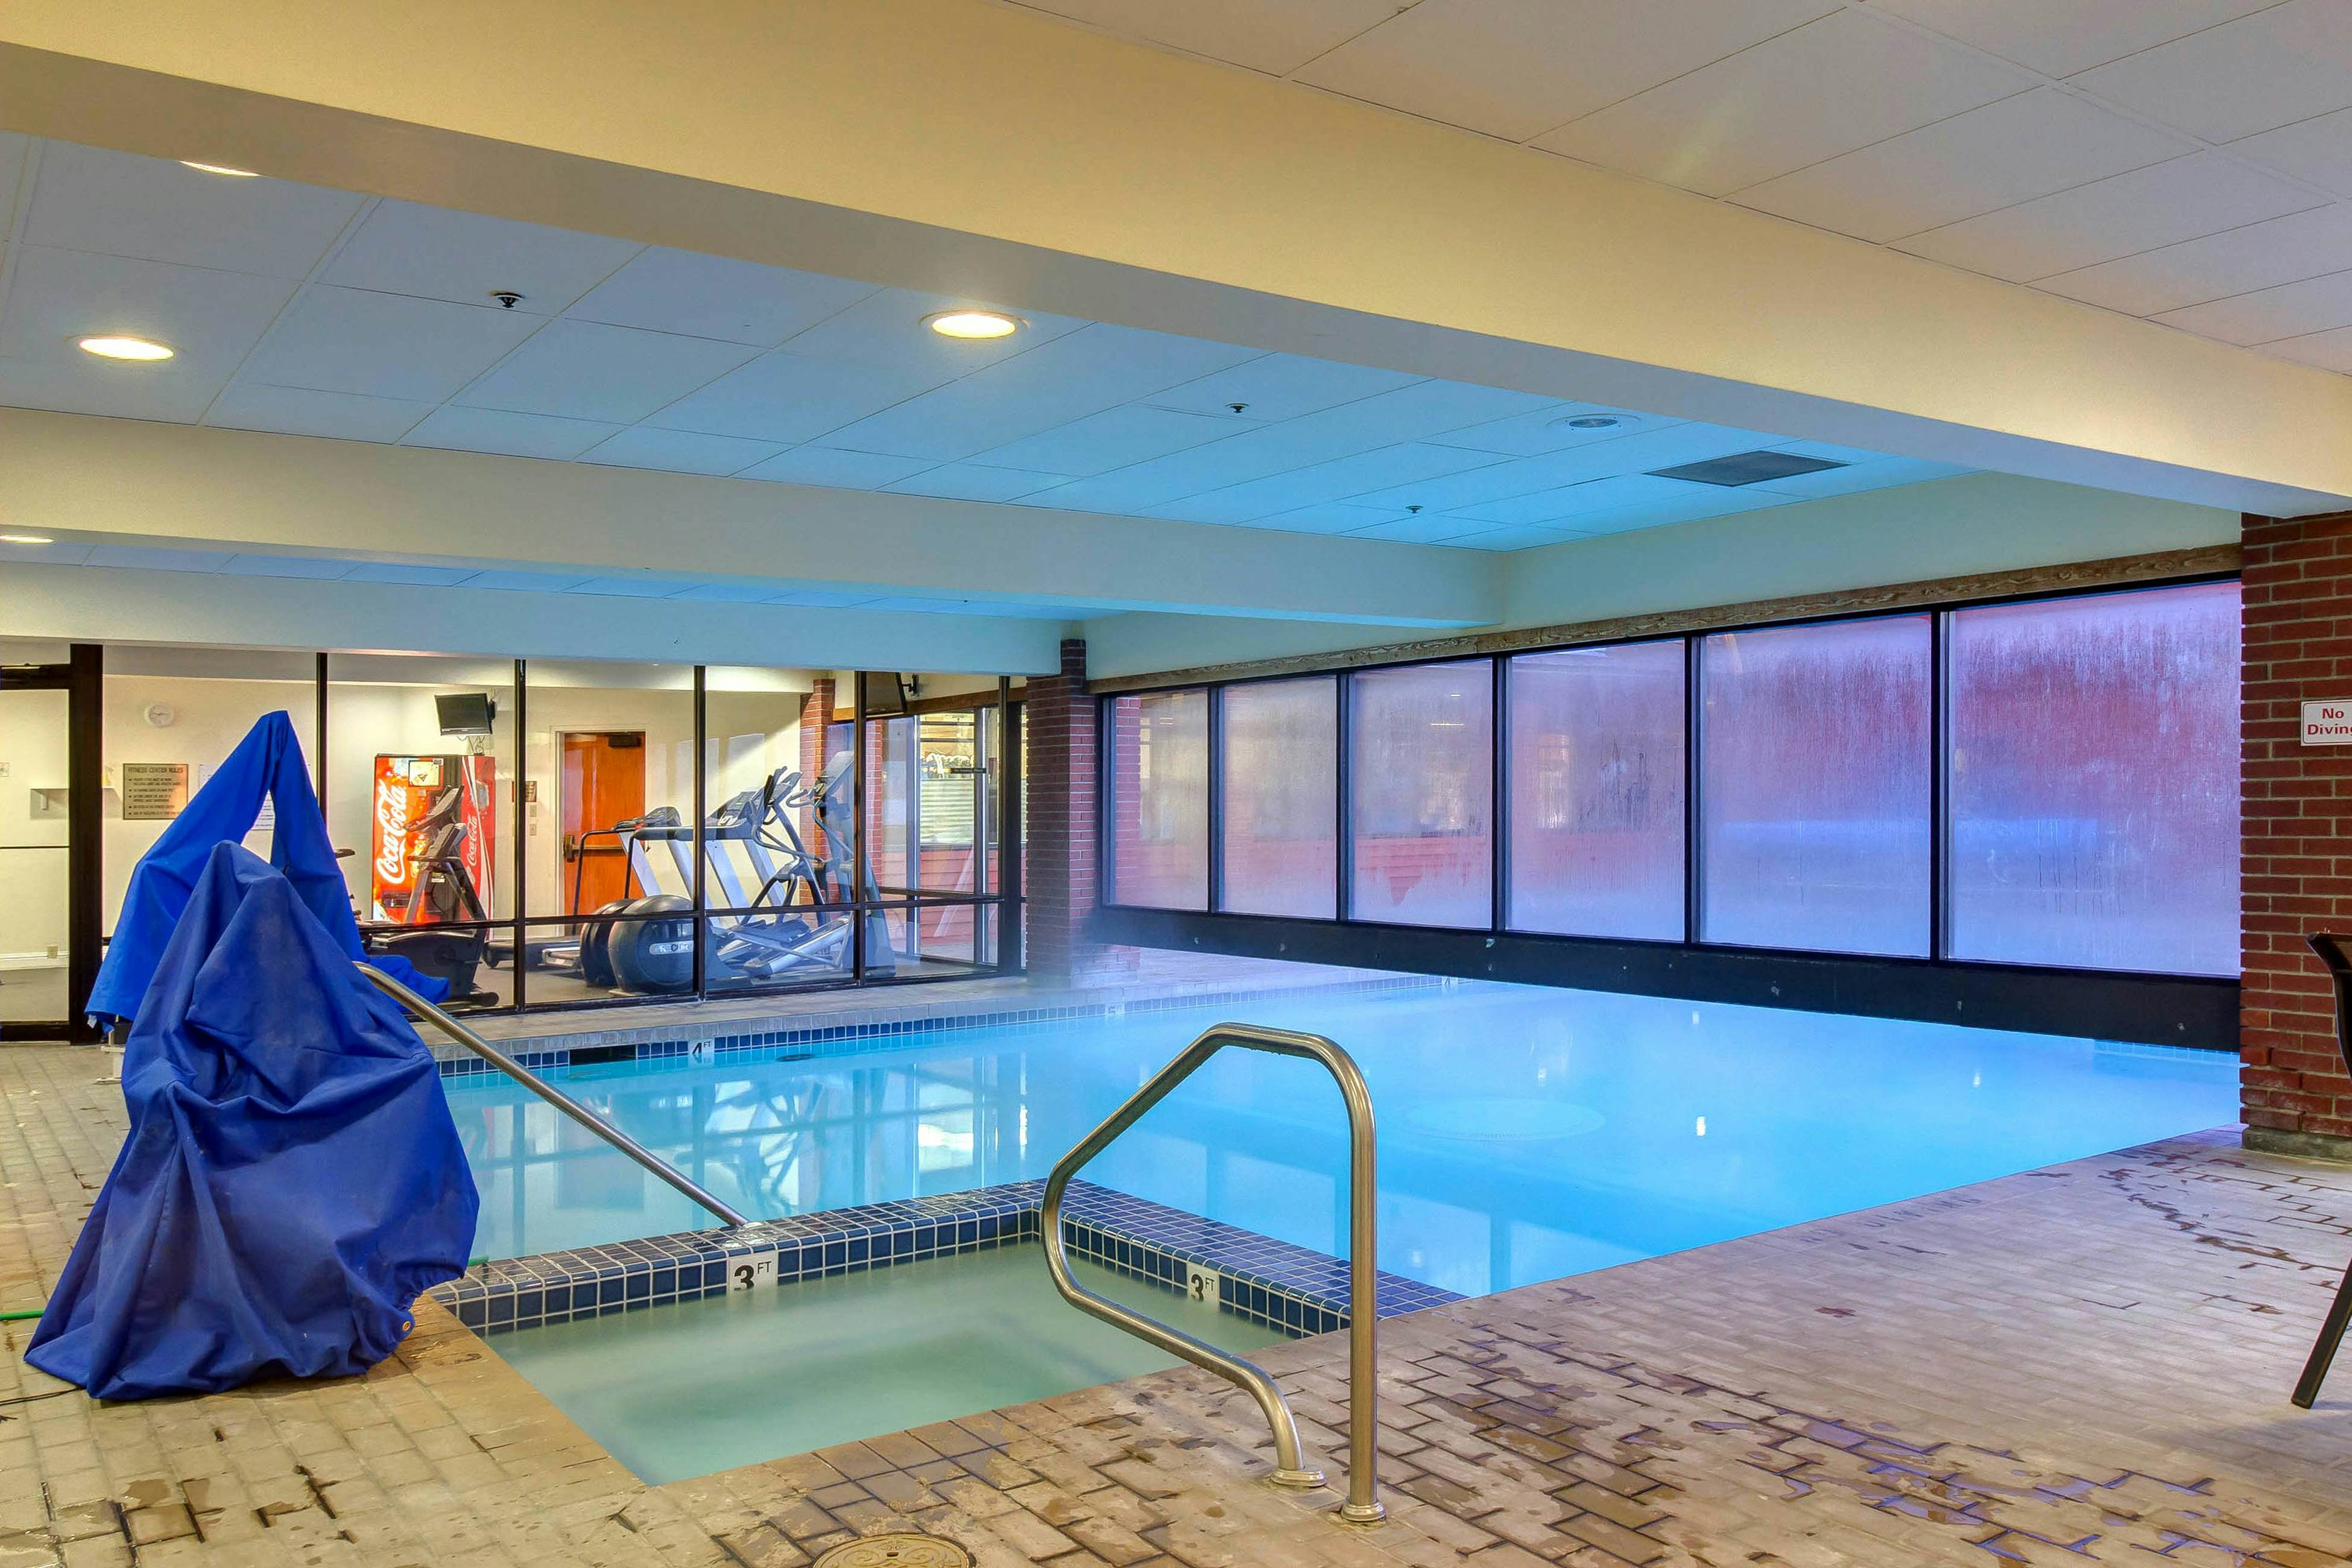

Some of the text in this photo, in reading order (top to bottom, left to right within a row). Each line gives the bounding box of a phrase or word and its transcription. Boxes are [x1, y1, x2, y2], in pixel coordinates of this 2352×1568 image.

[2322, 708, 2344, 719] No
[2307, 724, 2352, 736] Divin
[734, 1260, 771, 1290] 3 FT
[1191, 1274, 1215, 1302] 3 FT
